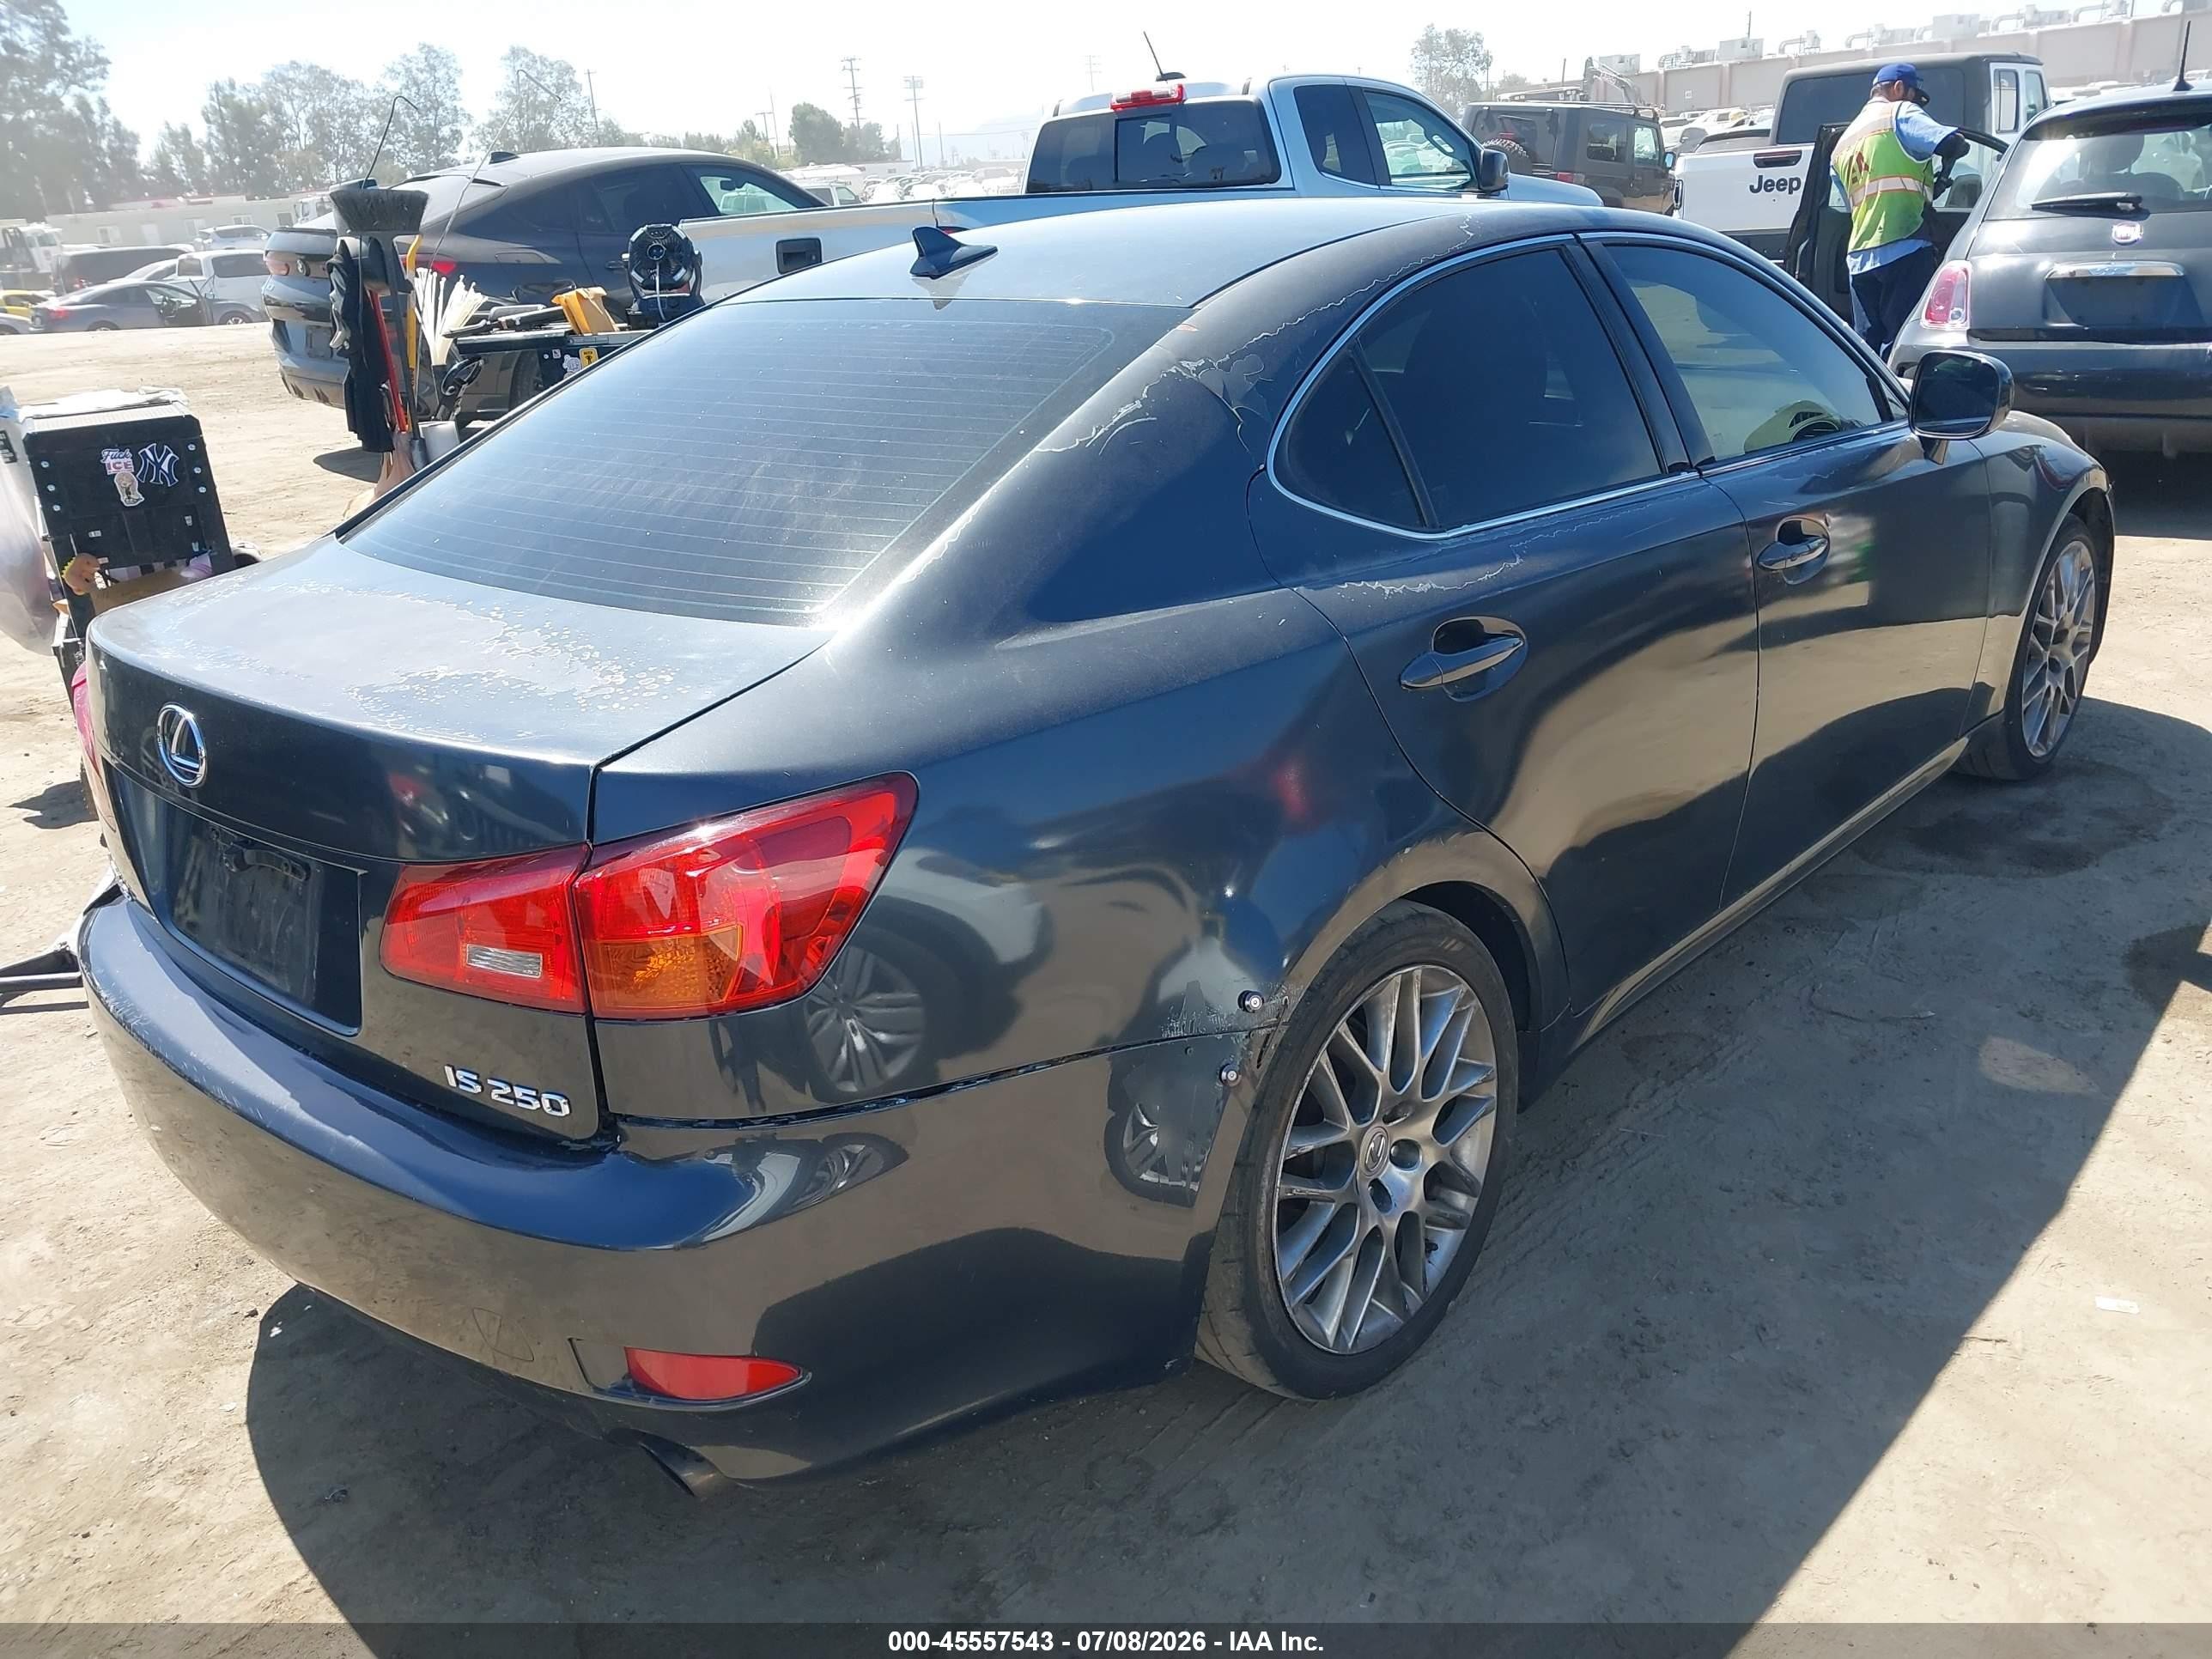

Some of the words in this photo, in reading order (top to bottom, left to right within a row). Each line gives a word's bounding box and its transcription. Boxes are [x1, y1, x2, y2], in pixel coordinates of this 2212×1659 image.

[1749, 174, 1802, 195] Jeep
[101, 448, 132, 463] Fuck
[106, 460, 133, 471] ICE
[444, 1065, 482, 1094] IS
[487, 1078, 570, 1117] 250
